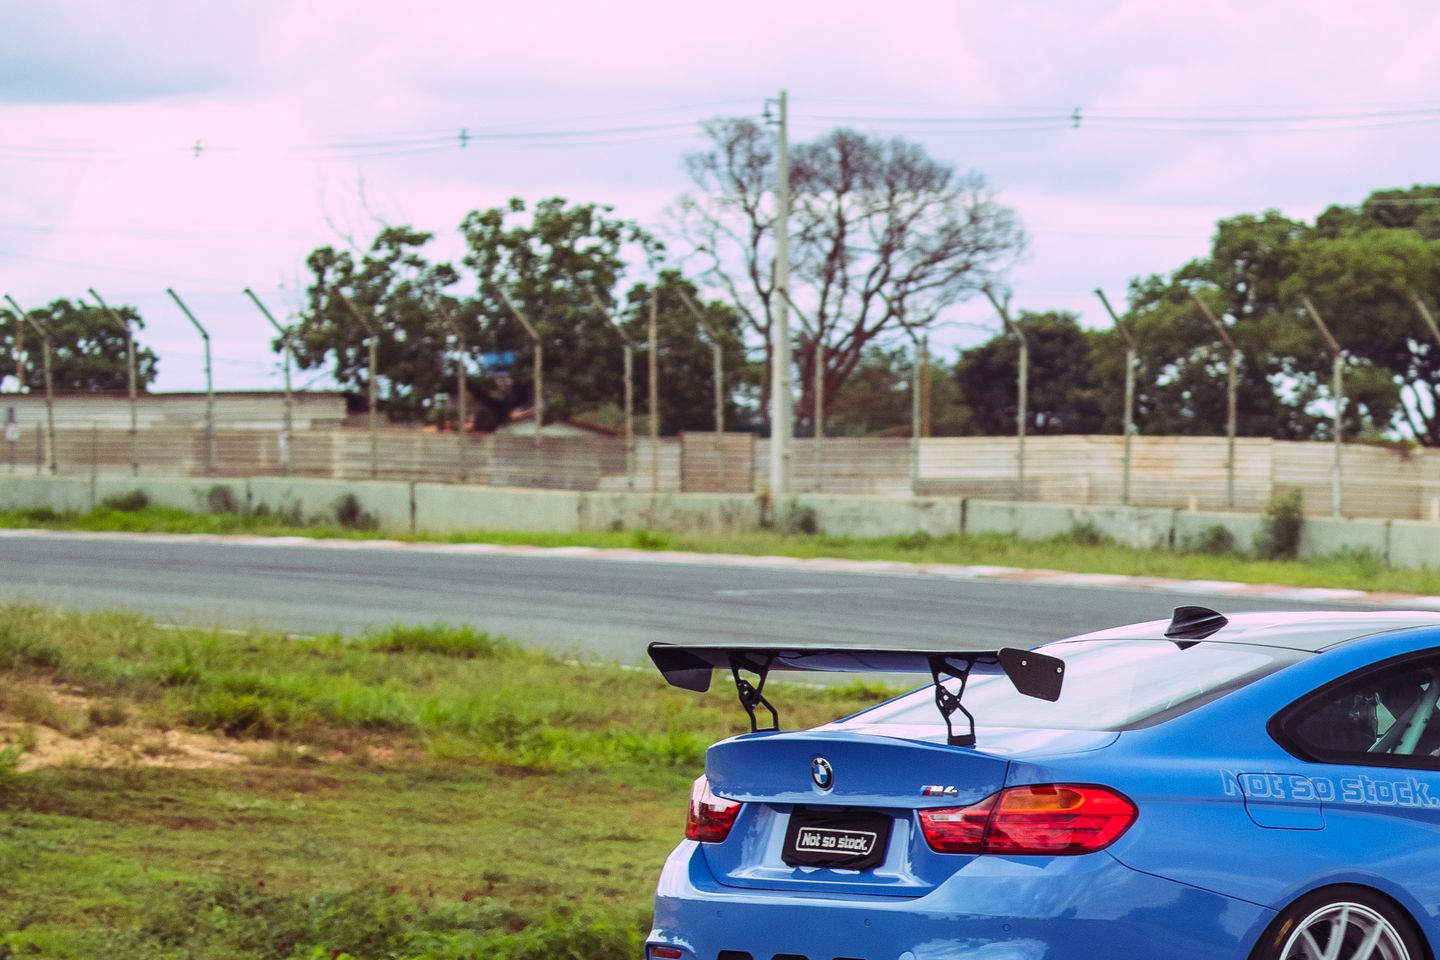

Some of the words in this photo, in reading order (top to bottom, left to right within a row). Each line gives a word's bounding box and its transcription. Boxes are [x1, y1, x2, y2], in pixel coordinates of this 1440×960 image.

[920, 785, 959, 798] M4
[1219, 769, 1286, 799] Not
[1290, 776, 1335, 802] so
[1340, 774, 1440, 809] stock.
[801, 832, 821, 847] Not
[821, 836, 836, 848] so
[837, 835, 868, 851] stock.
